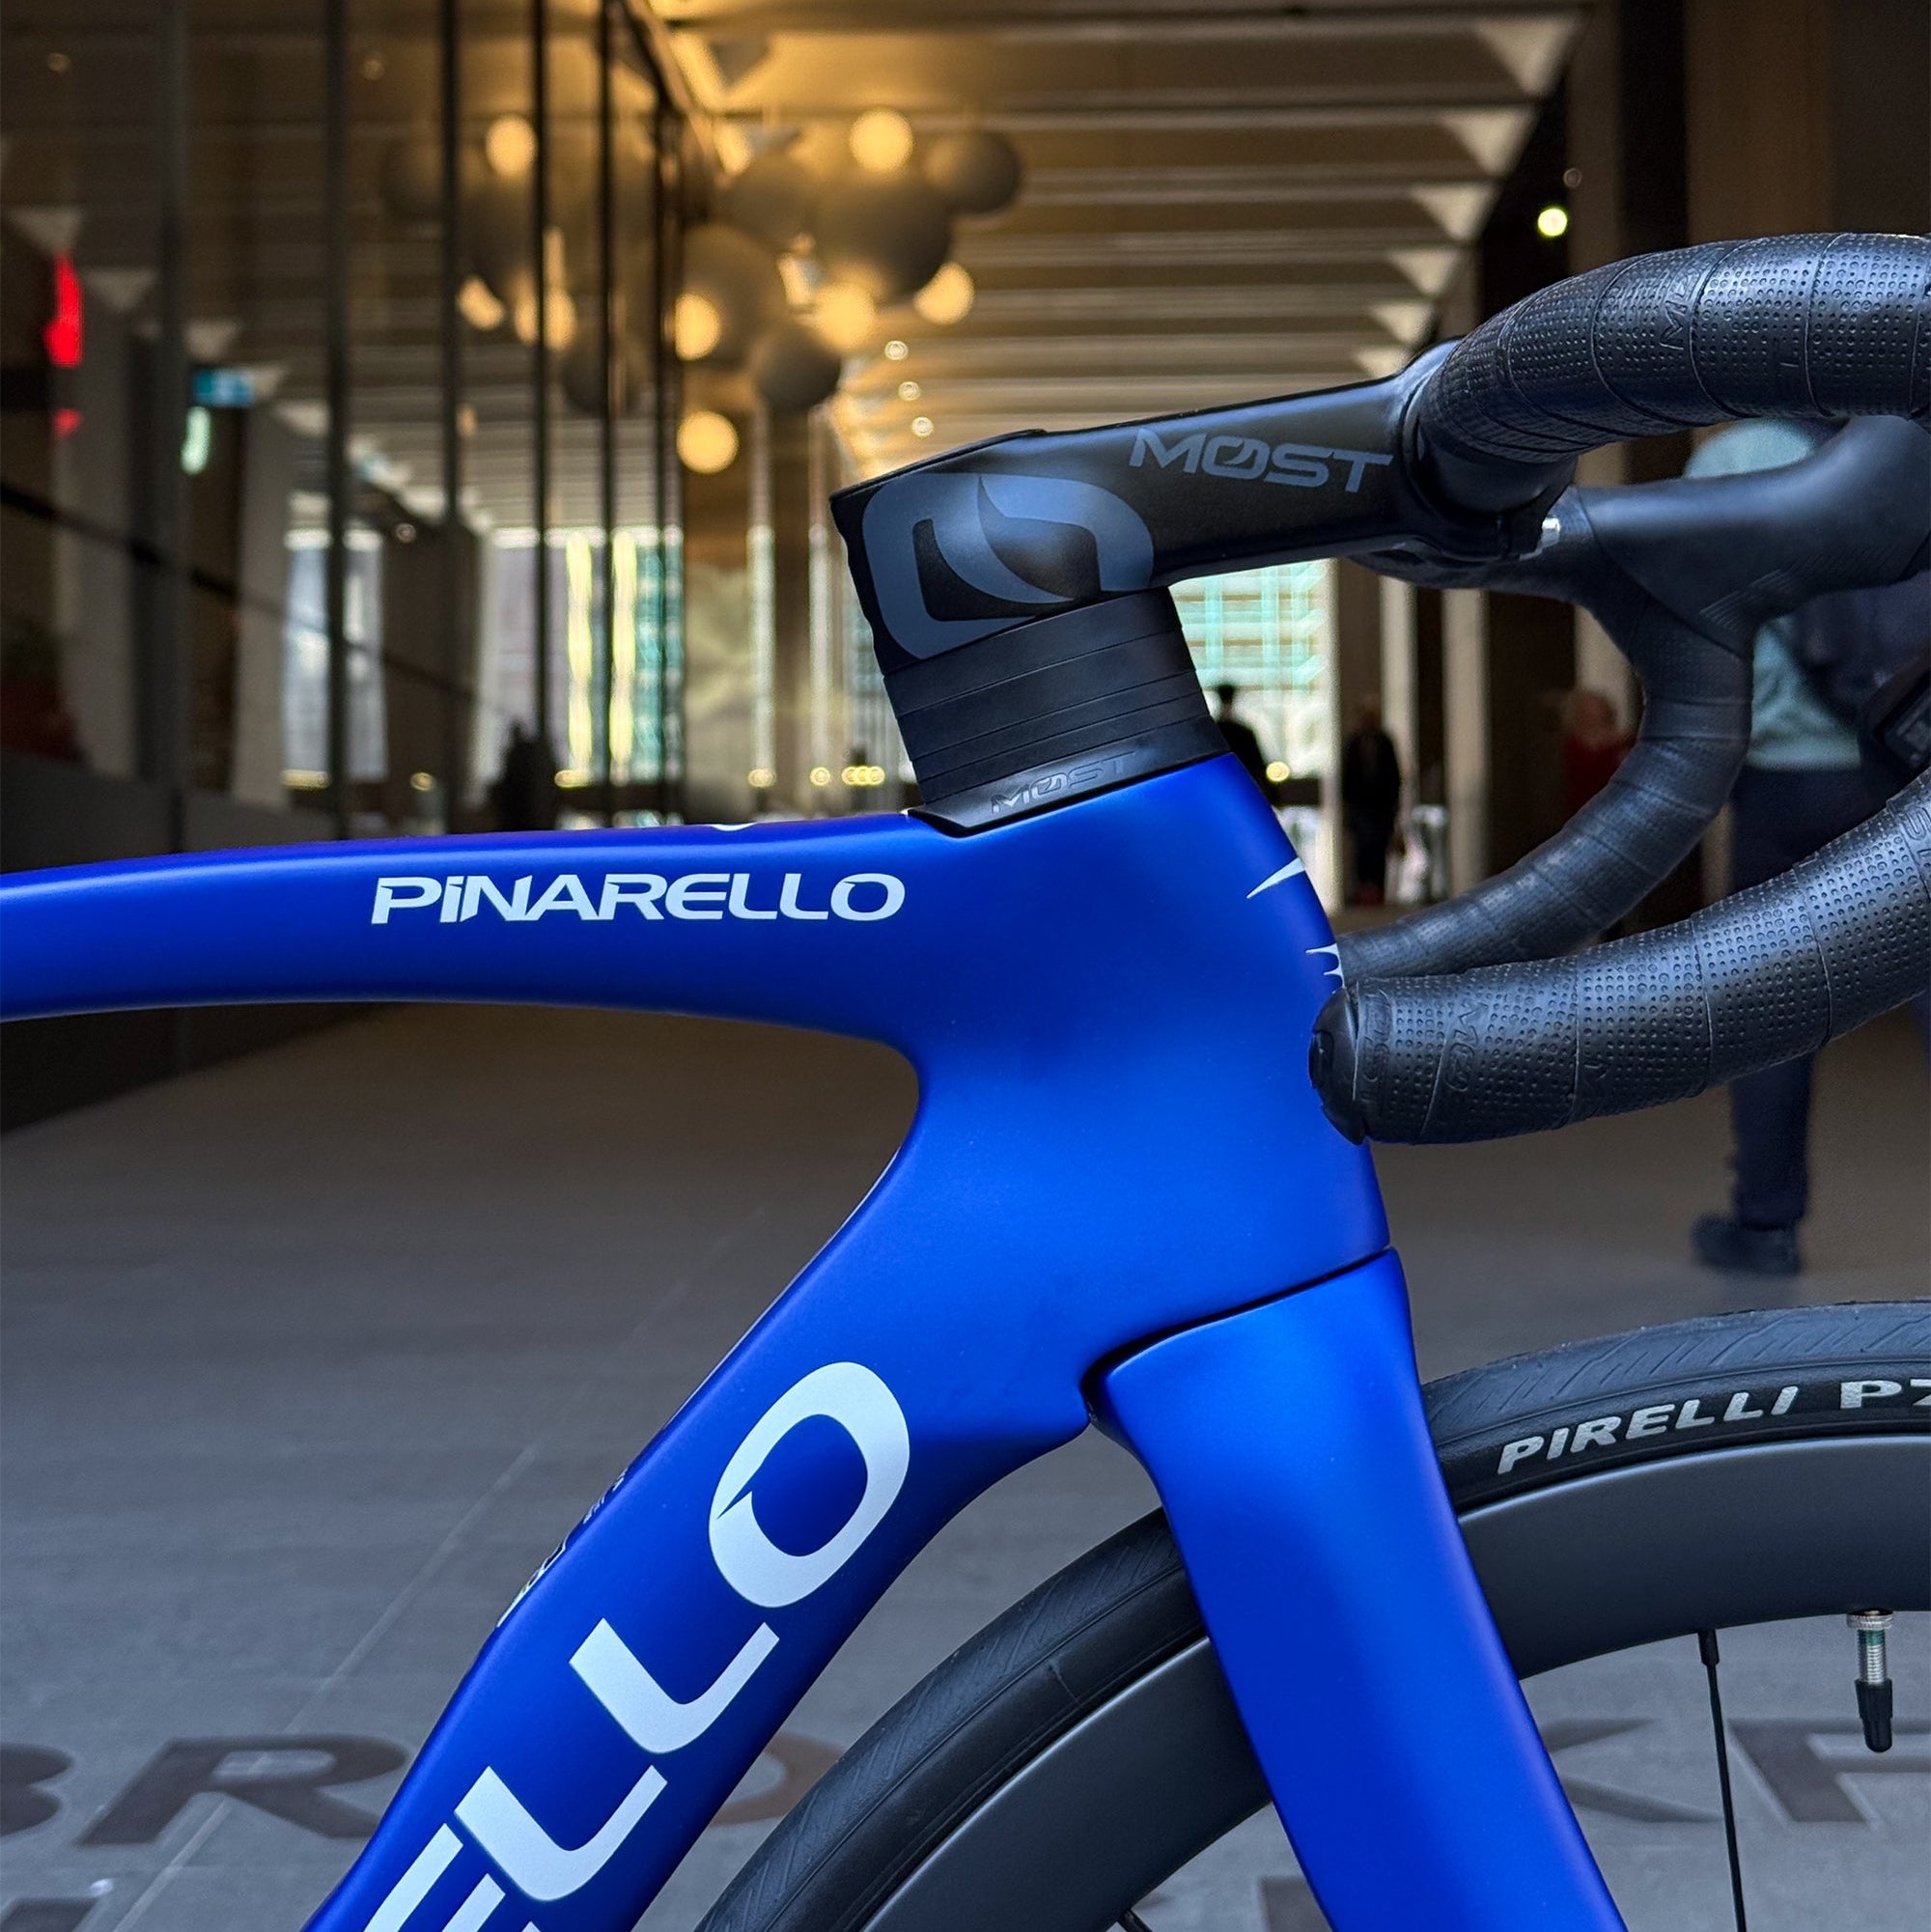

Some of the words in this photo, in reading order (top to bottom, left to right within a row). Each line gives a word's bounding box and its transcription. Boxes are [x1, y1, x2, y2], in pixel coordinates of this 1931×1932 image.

[1128, 429, 1392, 494] MOST
[990, 750, 1136, 815] MOST
[371, 872, 907, 924] PINARELLO
[1497, 1386, 1798, 1475] PIRELLI
